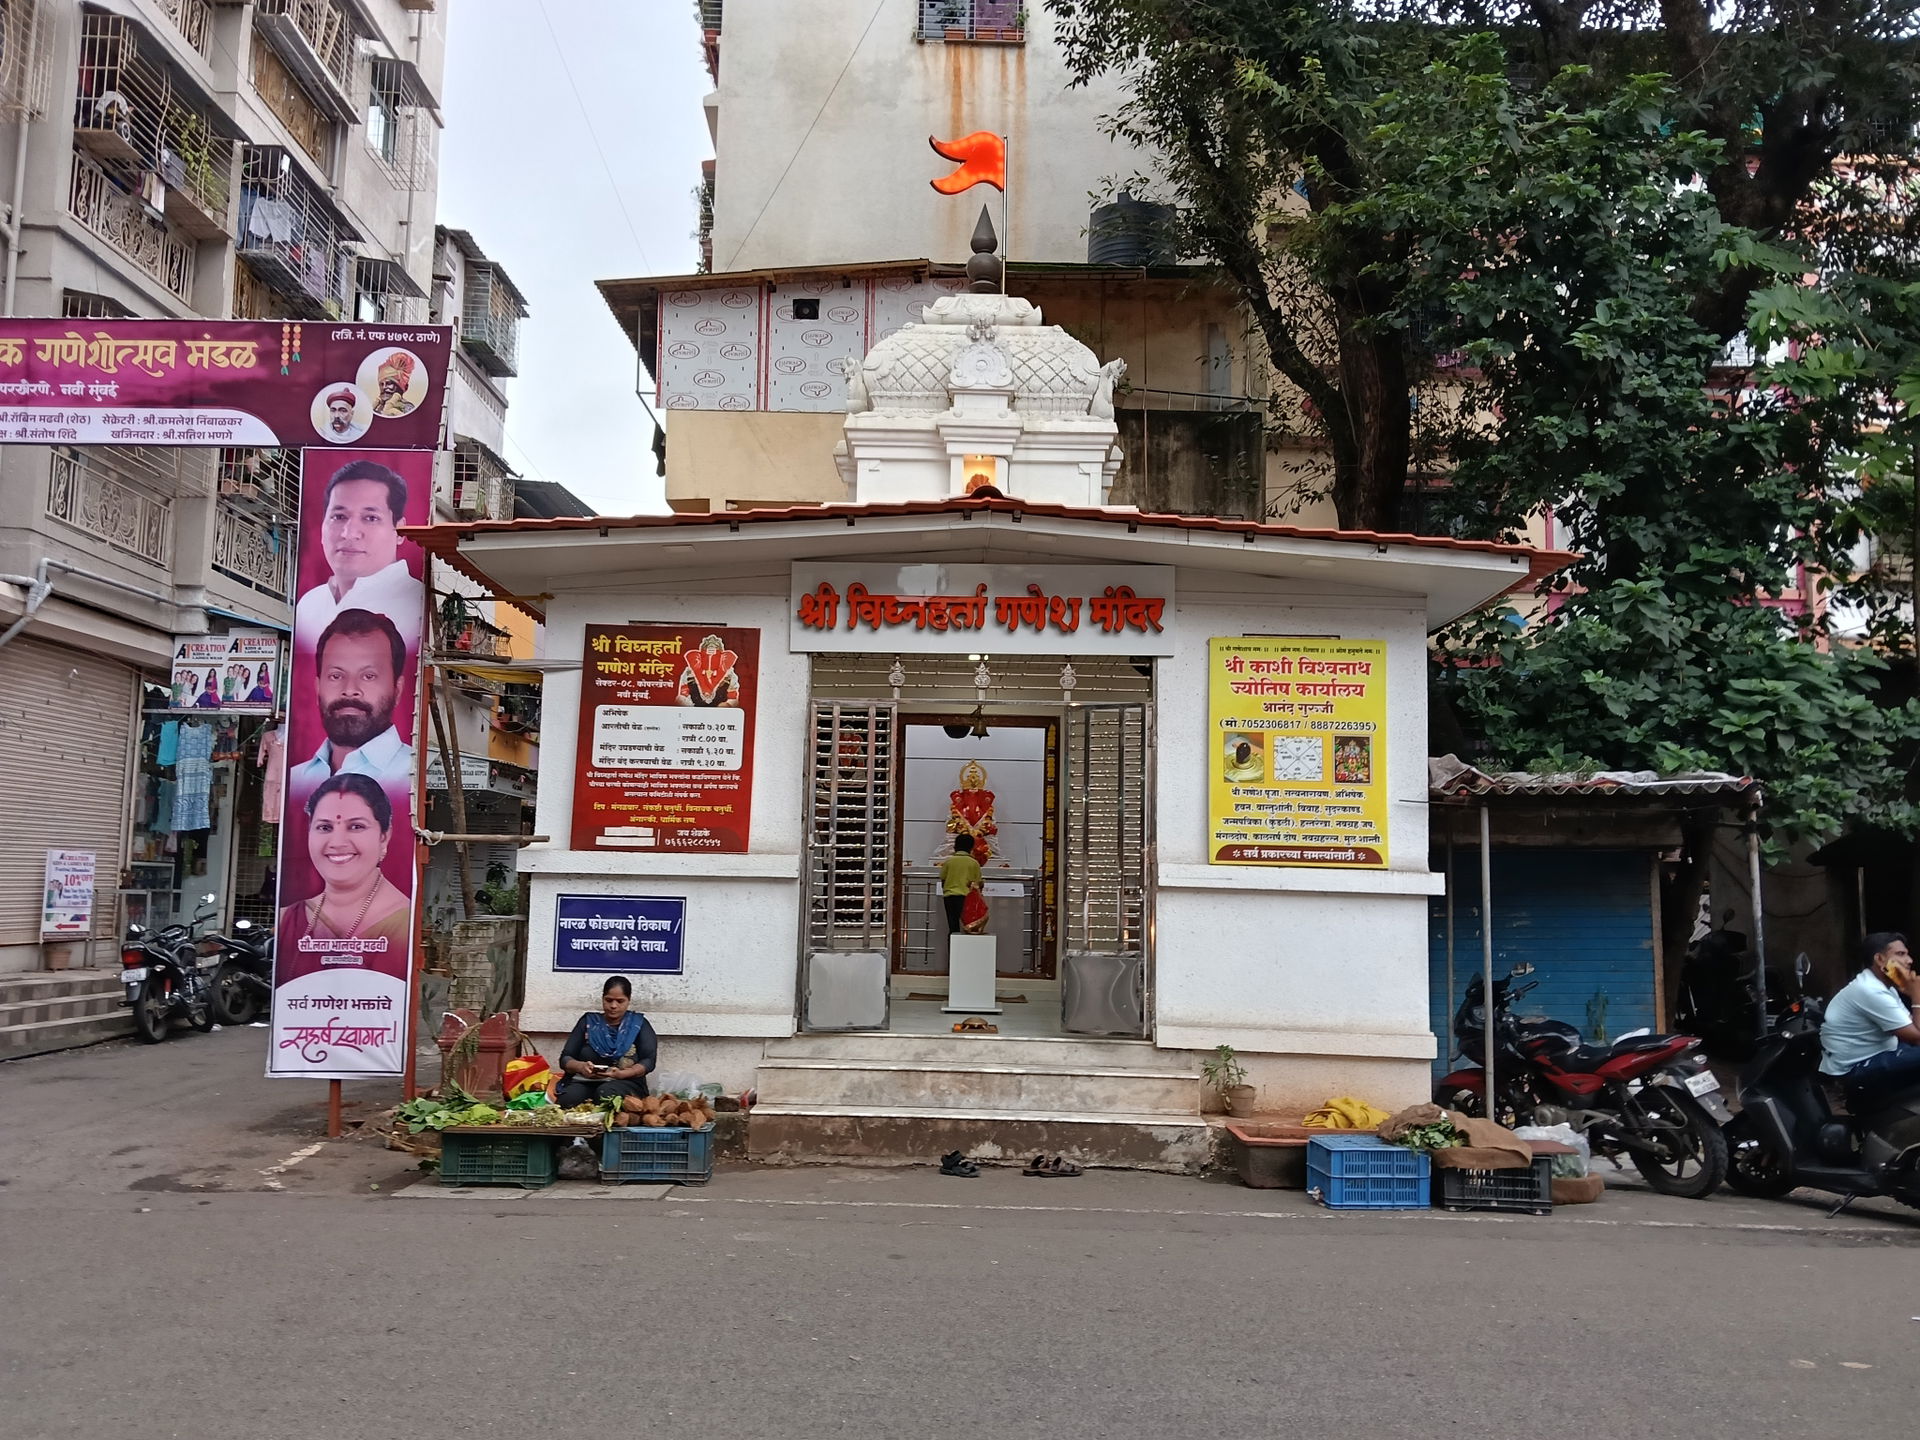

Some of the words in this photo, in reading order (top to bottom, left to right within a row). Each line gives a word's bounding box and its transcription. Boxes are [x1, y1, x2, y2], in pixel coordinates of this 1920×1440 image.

[368, 331, 386, 341] एफ
[387, 332, 415, 342] ४७९८
[416, 331, 441, 344] ठाणे)
[33, 331, 178, 377] गणेशोत्सव
[184, 333, 259, 370] मंडळ
[38, 413, 64, 424] मढवी
[66, 413, 91, 425] (शेठ)
[102, 413, 135, 425] सेक्रेटरी
[143, 414, 194, 426] श्री.कमलेश
[196, 415, 243, 426] निंबाळकर
[15, 428, 55, 439] श्री.संतोष
[58, 428, 77, 440] शिंदे
[111, 429, 154, 440] खजिनदार
[163, 430, 205, 440] श्री.सतिश
[207, 429, 232, 440] भणगे
[797, 582, 840, 629] श्री
[847, 582, 988, 631] विघ्नहर्ता
[995, 584, 1083, 632] गणेश
[1089, 586, 1165, 632] मंदिर
[191, 644, 227, 653] CREATION
[243, 638, 278, 646] CREATION
[592, 635, 611, 653] श्री
[615, 635, 682, 657] विघ्नहर्ता
[597, 658, 634, 675] गणेश
[639, 659, 675, 678] मंदिर
[1225, 656, 1244, 674] श्री
[1249, 656, 1293, 675] काशी
[1298, 656, 1371, 676] विश्वनाथ
[1230, 677, 1291, 696] ज्योतिष
[1295, 678, 1365, 697] कार्यालय
[1263, 700, 1294, 715] आनंद
[1243, 847, 1259, 859] सर्व
[64, 874, 81, 886] 10%
[560, 918, 587, 930] नारळ
[588, 914, 636, 930] फोडण्याचे
[637, 916, 672, 931] ठिकाण
[363, 936, 386, 951] मढवी
[621, 936, 639, 951] येथे
[640, 941, 669, 952] लावा.
[287, 995, 308, 1010] सर्व
[311, 995, 348, 1010] गणेश
[352, 995, 393, 1010] भक्तांचे
